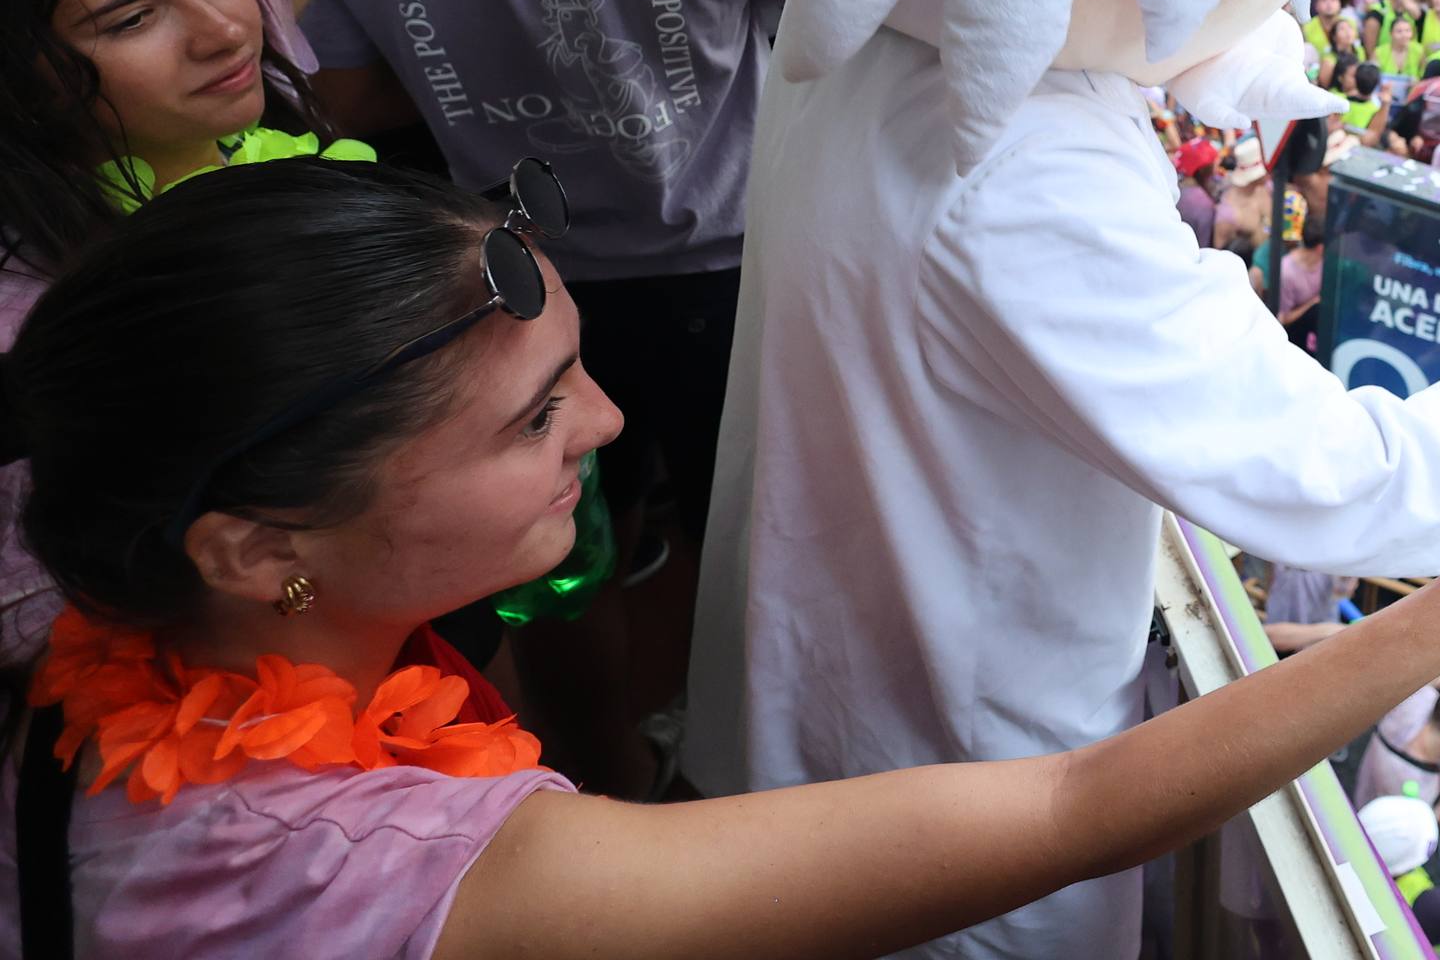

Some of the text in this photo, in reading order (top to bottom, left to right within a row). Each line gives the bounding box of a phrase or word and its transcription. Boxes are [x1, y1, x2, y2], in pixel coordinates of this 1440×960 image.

[424, 63, 474, 127] THE
[481, 93, 674, 140] FOC ON
[1373, 274, 1429, 310] UNA
